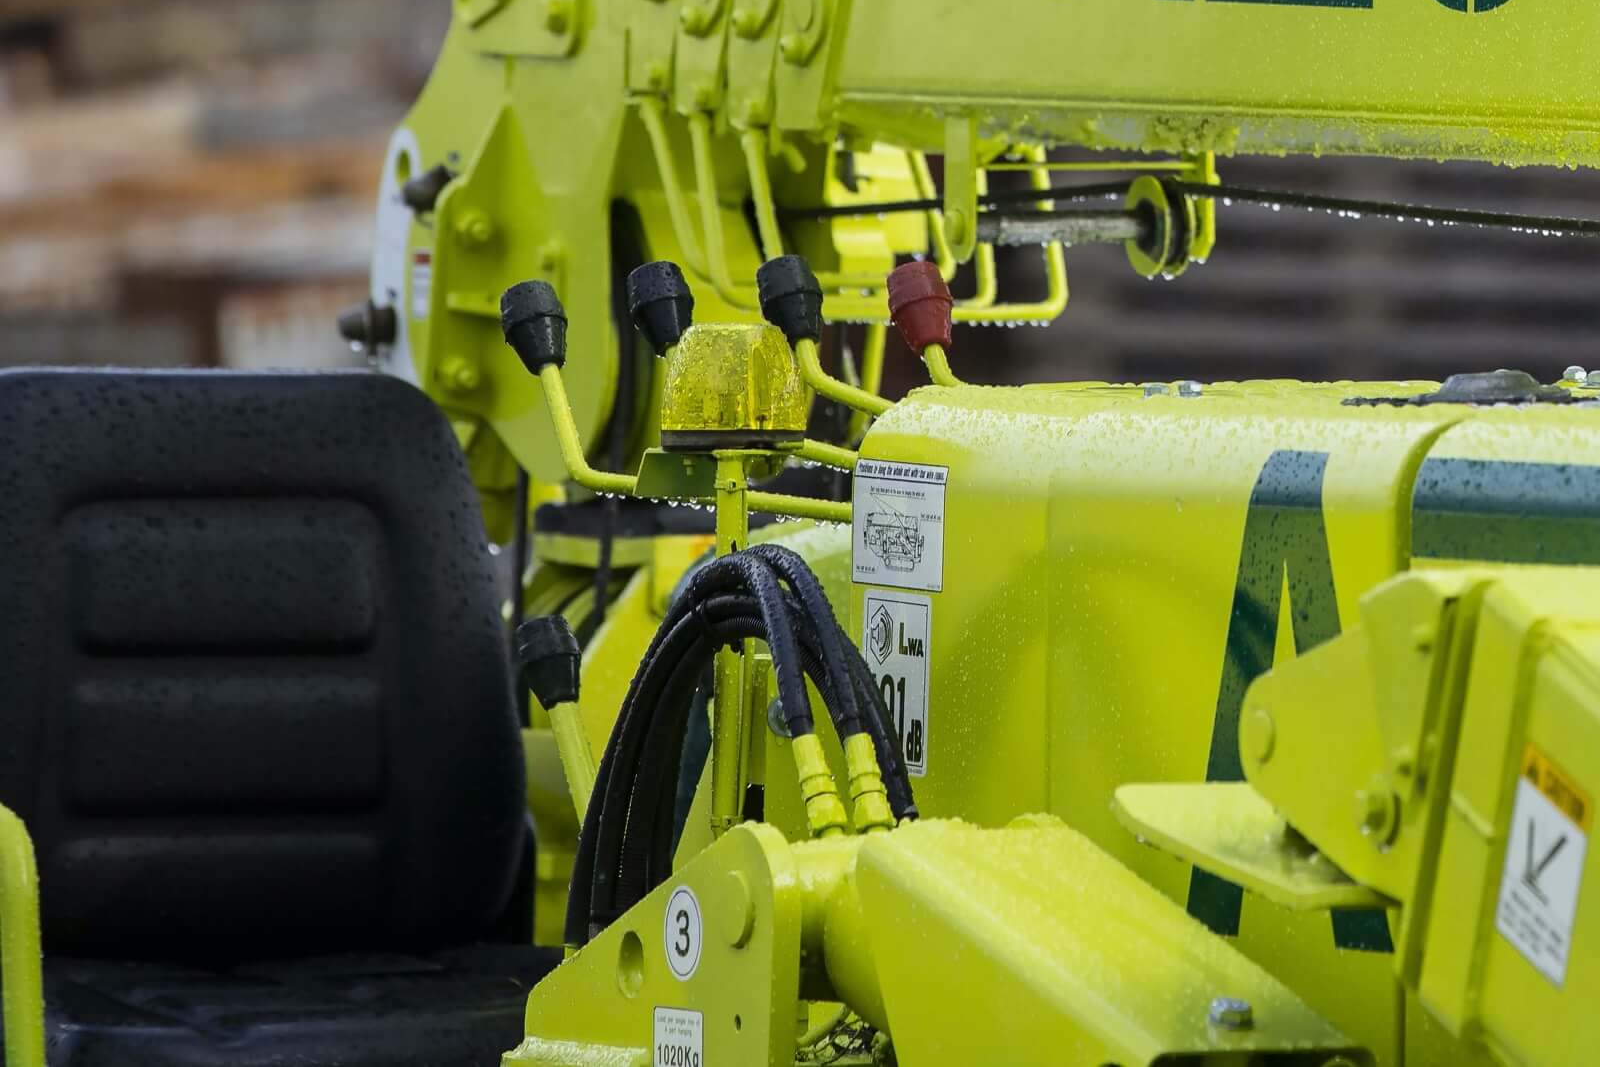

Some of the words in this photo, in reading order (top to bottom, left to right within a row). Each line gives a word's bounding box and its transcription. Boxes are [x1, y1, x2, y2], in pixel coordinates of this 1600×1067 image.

[905, 718, 922, 763] dB
[674, 909, 690, 957] 3
[657, 1042, 699, 1067] 1020Kg
